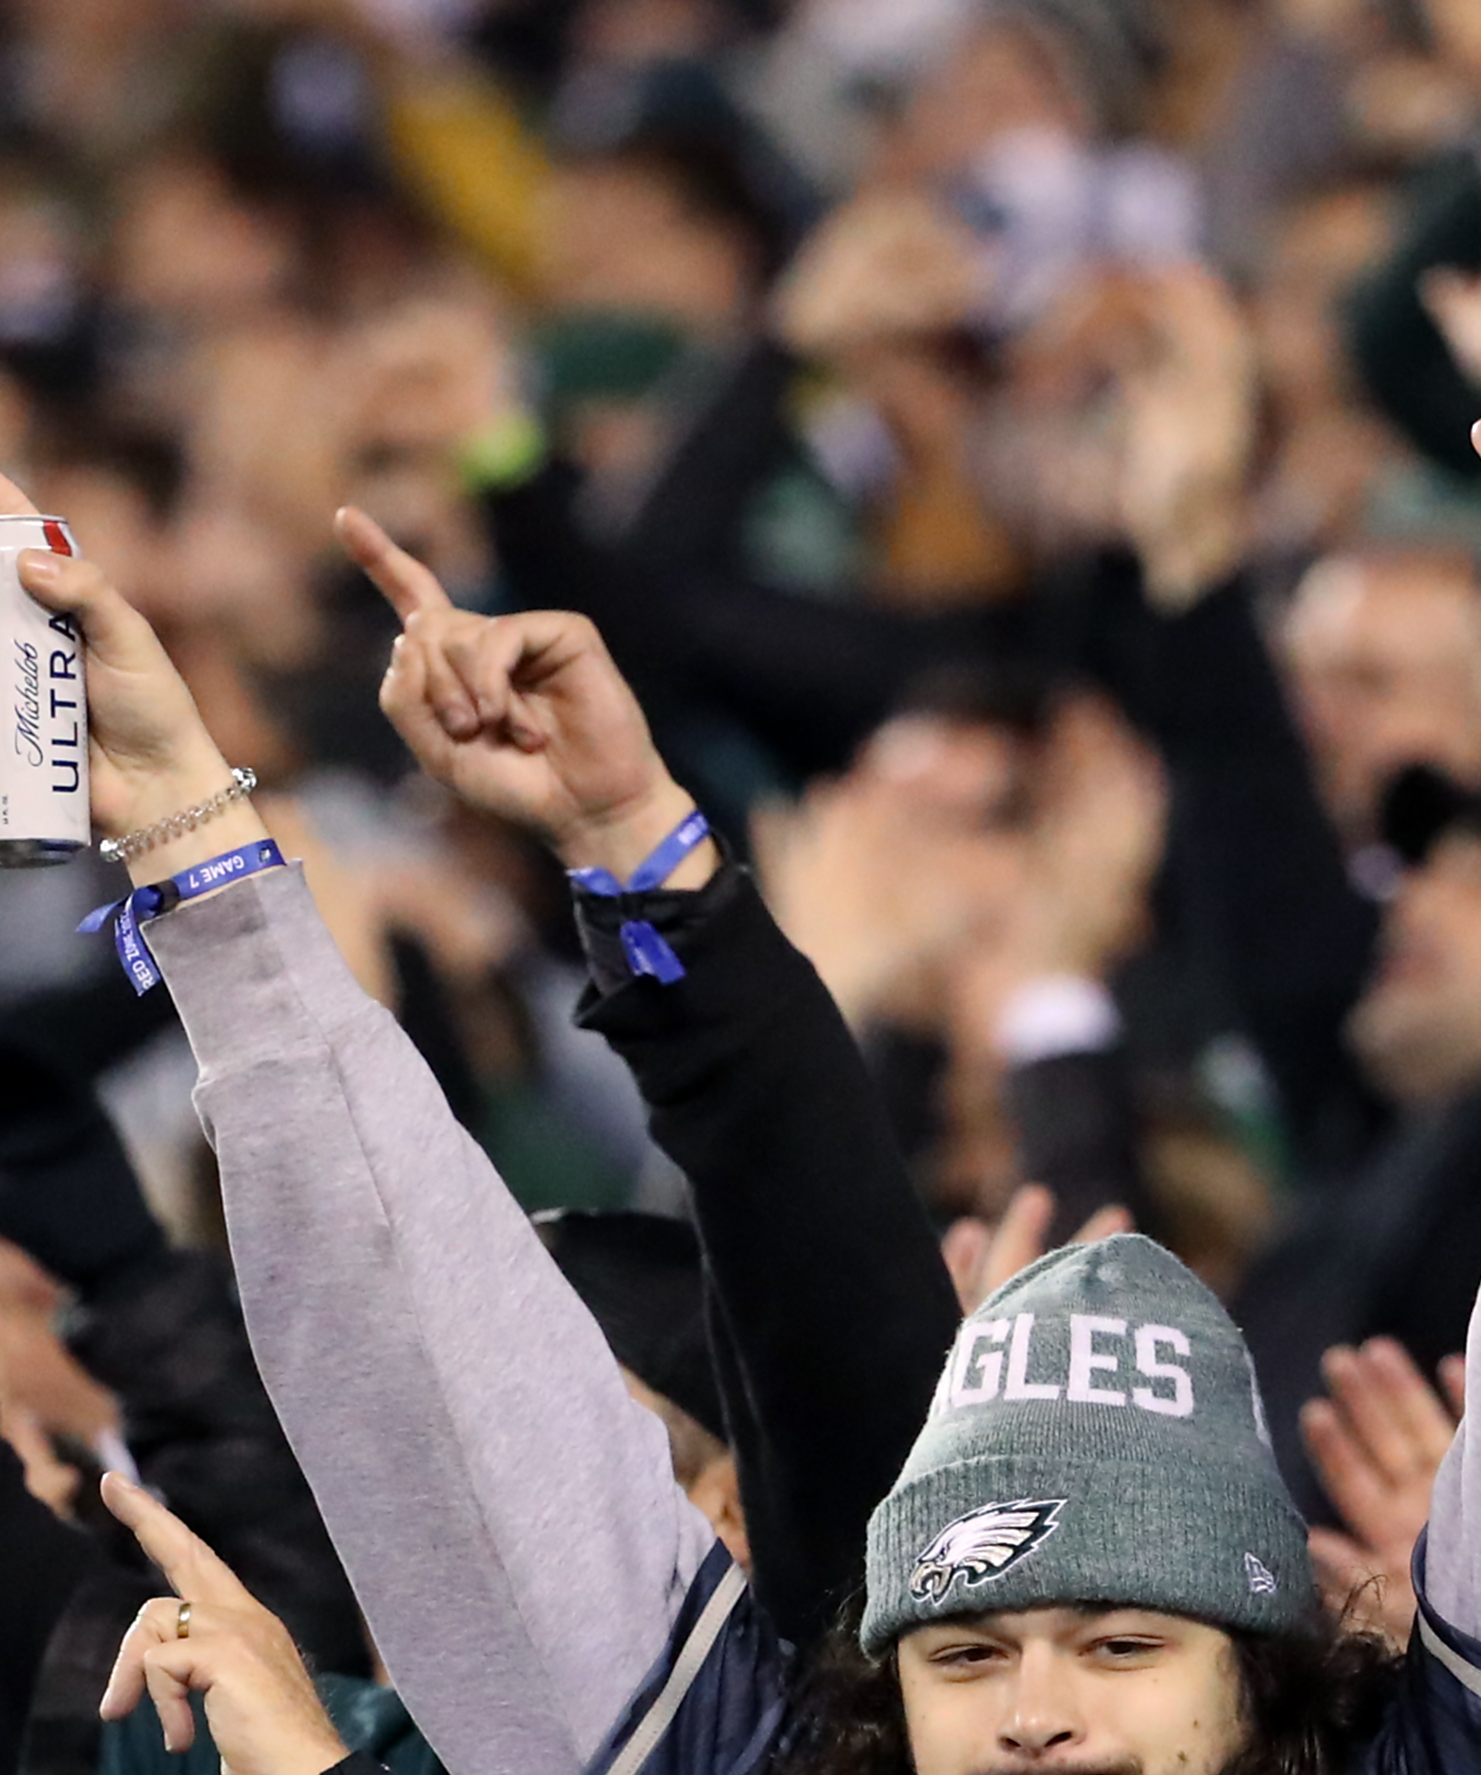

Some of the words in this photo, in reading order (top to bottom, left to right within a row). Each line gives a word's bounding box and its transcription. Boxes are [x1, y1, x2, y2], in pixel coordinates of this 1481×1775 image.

[14, 638, 44, 767] Michelob
[48, 612, 80, 793] ULTRA
[188, 873, 200, 889] 7
[199, 854, 245, 884] GAME
[132, 959, 156, 990] RED
[938, 1313, 1195, 1417] GLES
